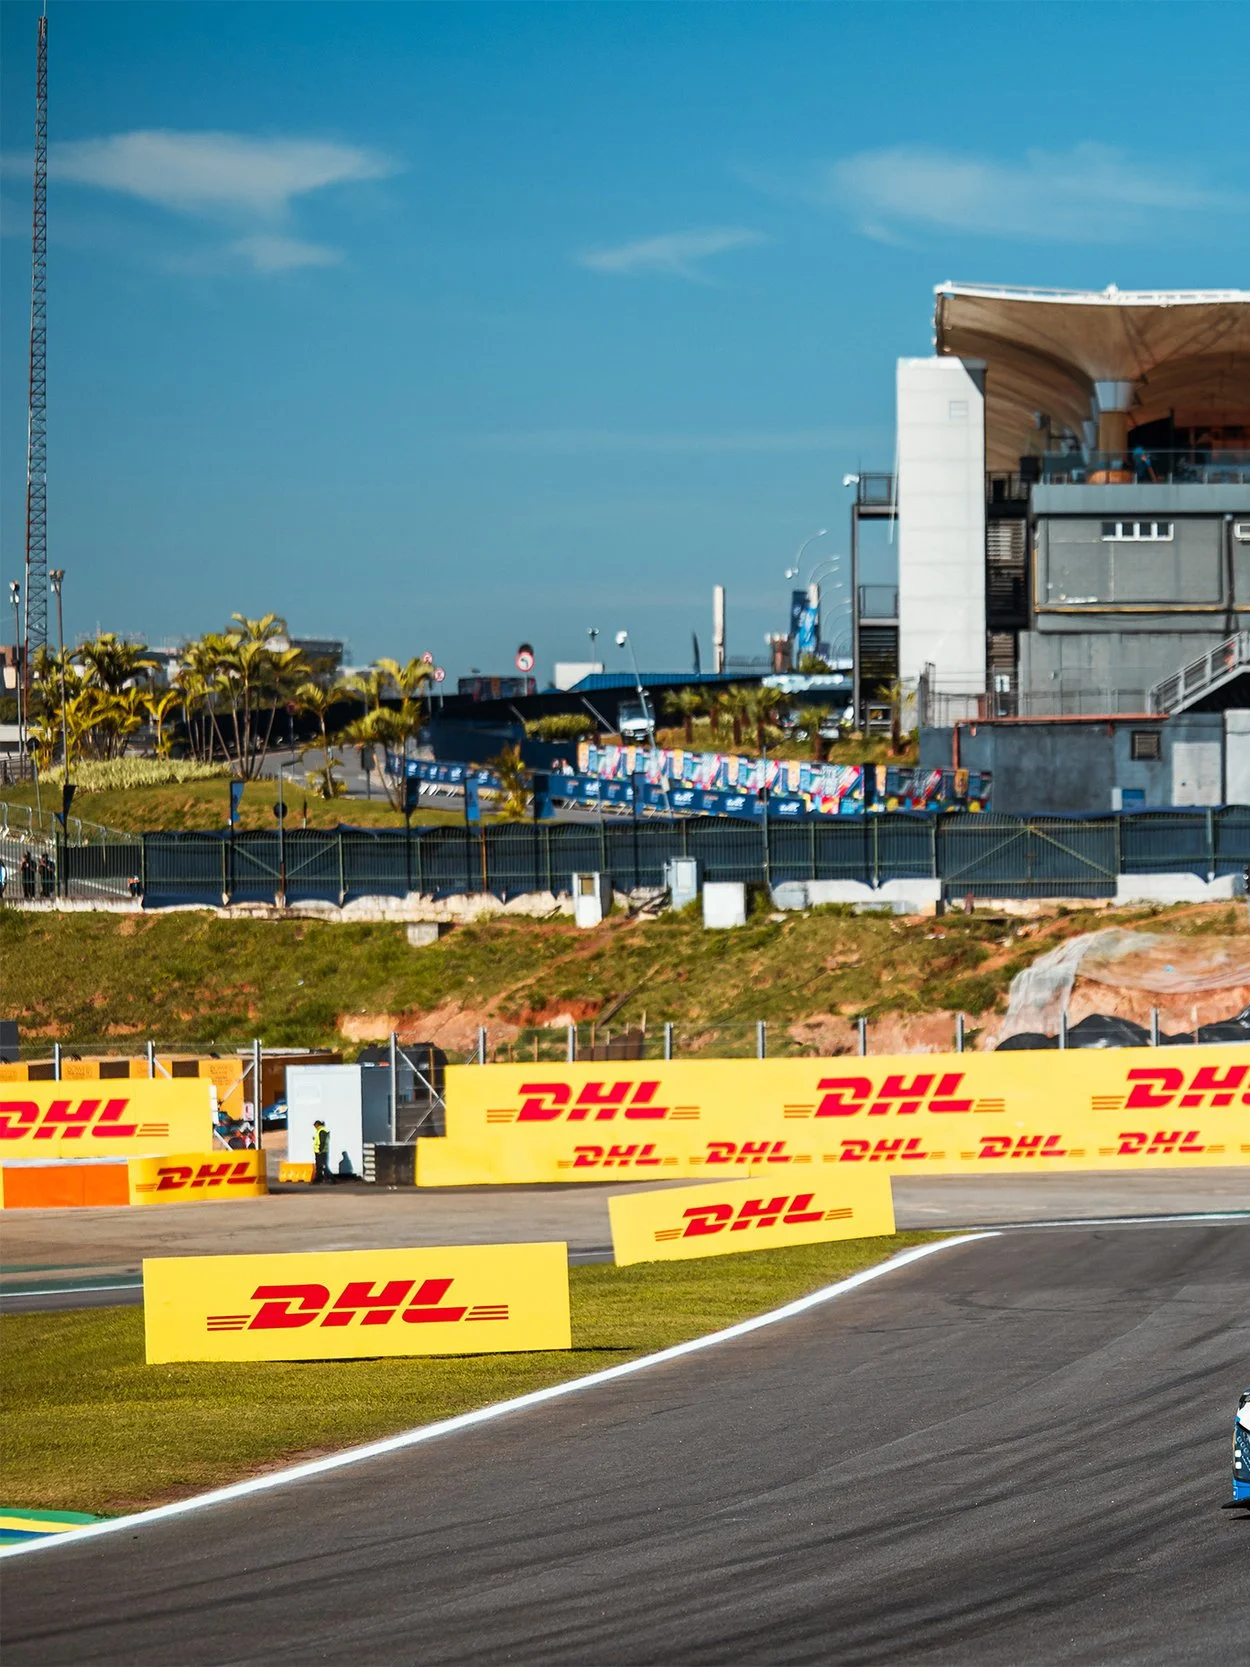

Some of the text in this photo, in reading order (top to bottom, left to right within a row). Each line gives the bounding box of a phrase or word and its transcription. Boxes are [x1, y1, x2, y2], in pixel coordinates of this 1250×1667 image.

[517, 1081, 668, 1121] DHL
[815, 1073, 973, 1117] DHL
[0, 1099, 138, 1139] DHL
[573, 1144, 660, 1167] DHL
[706, 1141, 791, 1163] DHL
[839, 1138, 926, 1161] DHL
[979, 1135, 1066, 1158] DHL
[1118, 1131, 1204, 1154] DHL
[156, 1162, 257, 1191] DHL
[683, 1193, 825, 1237] DHL
[247, 1278, 468, 1330] DHL
